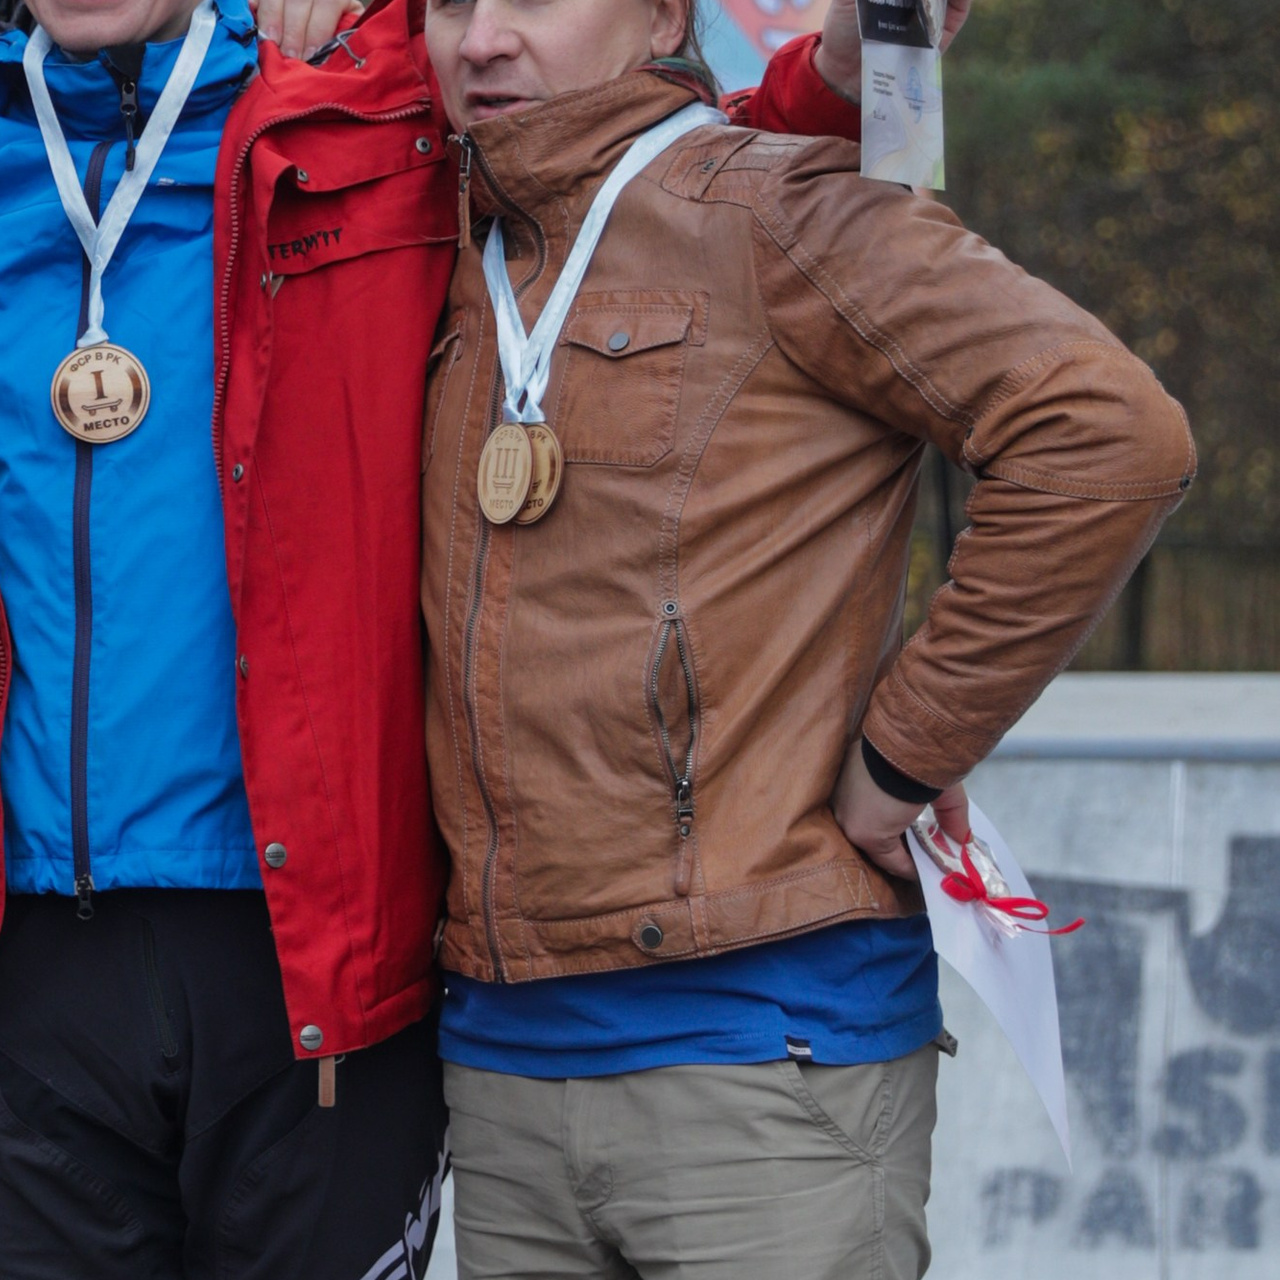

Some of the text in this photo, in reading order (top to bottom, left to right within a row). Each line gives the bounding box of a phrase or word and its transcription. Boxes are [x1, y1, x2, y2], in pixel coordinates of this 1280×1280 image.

[70, 351, 122, 373] ФСР В РК
[83, 416, 130, 432] МЕСТО
[525, 498, 544, 510] СТО
